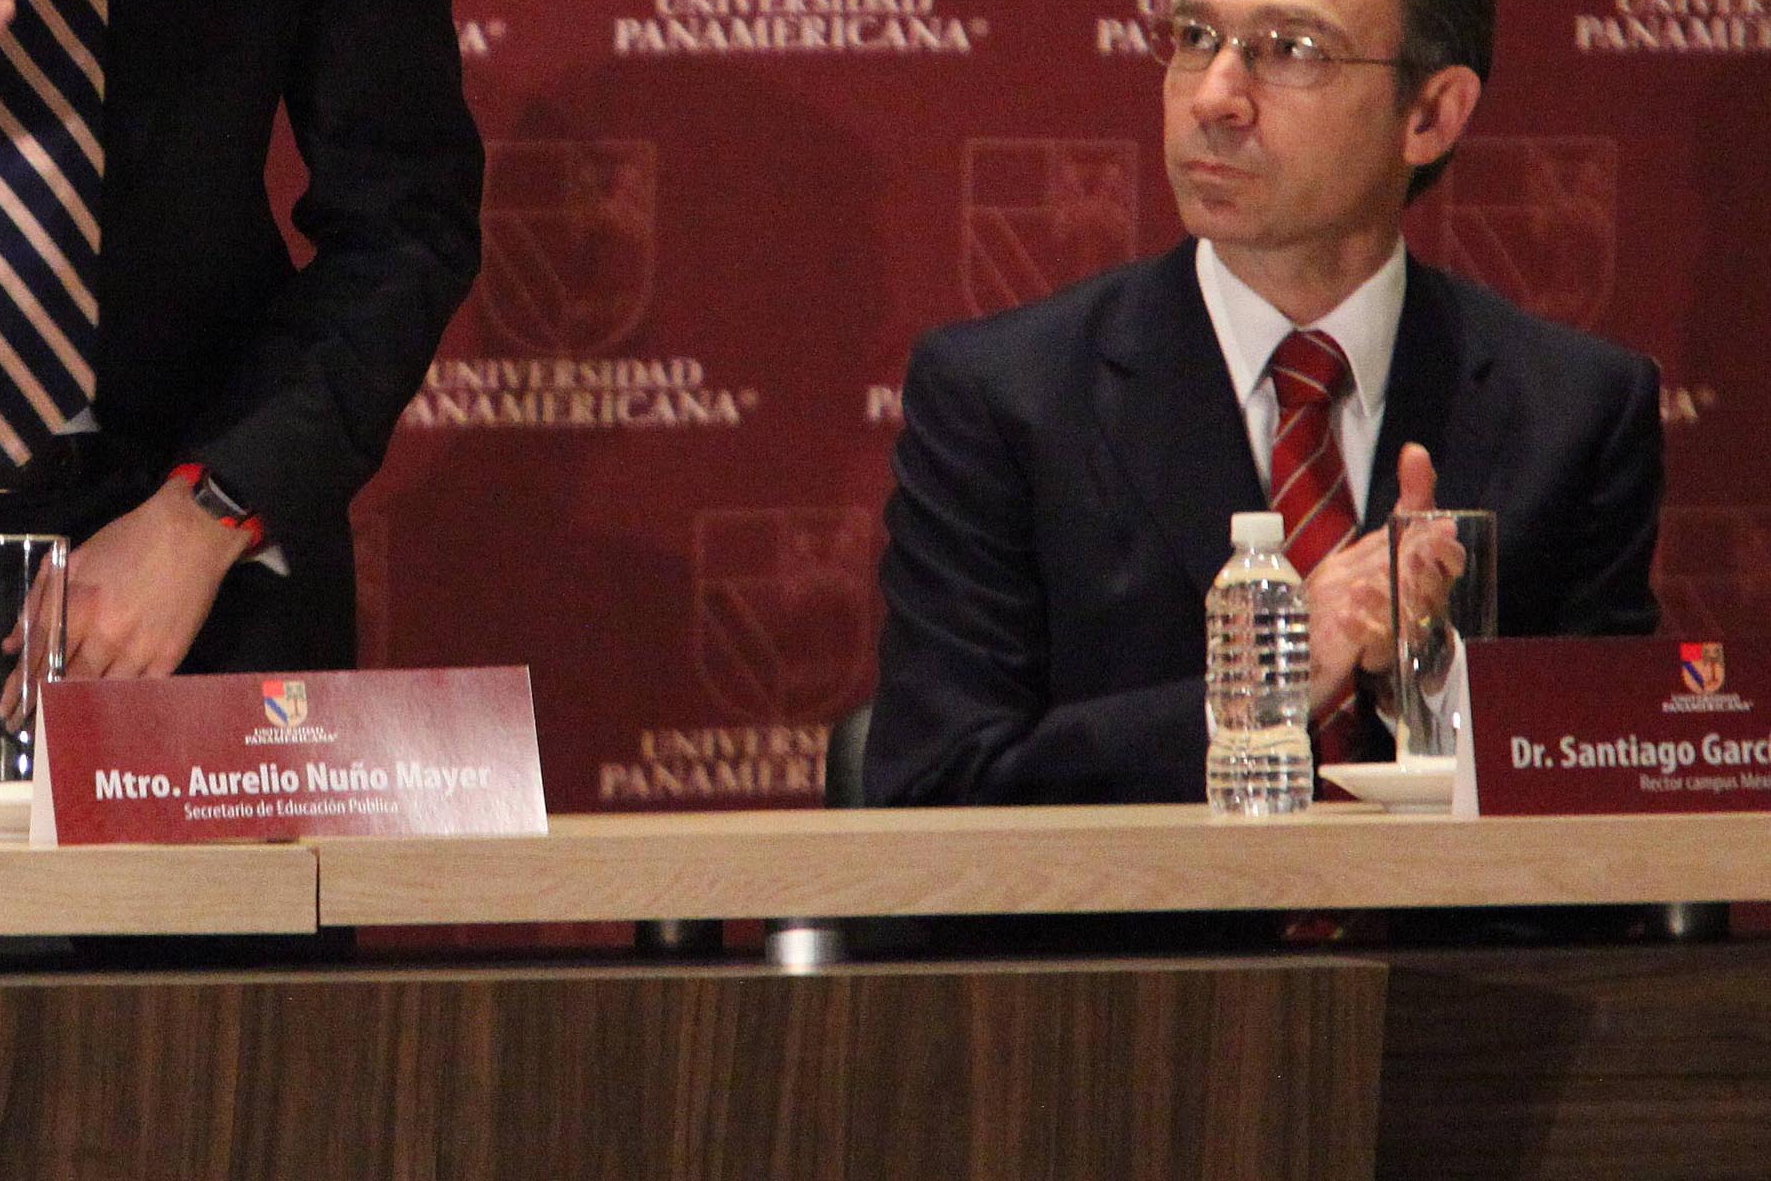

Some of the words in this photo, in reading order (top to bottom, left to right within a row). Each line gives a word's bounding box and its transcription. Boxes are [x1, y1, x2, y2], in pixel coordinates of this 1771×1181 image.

[614, 17, 972, 55] PANAMERICANA
[398, 390, 743, 425] ANAMERICANA
[1510, 735, 1554, 769] Dr.
[1559, 734, 1696, 774] Santiago
[1702, 732, 1771, 766] Garc
[94, 768, 182, 801] Mtro.
[188, 763, 299, 797] Aurelio
[305, 759, 388, 792] Nuño
[396, 759, 491, 796] Mayer
[184, 800, 253, 820] Secretario
[256, 800, 274, 816] de
